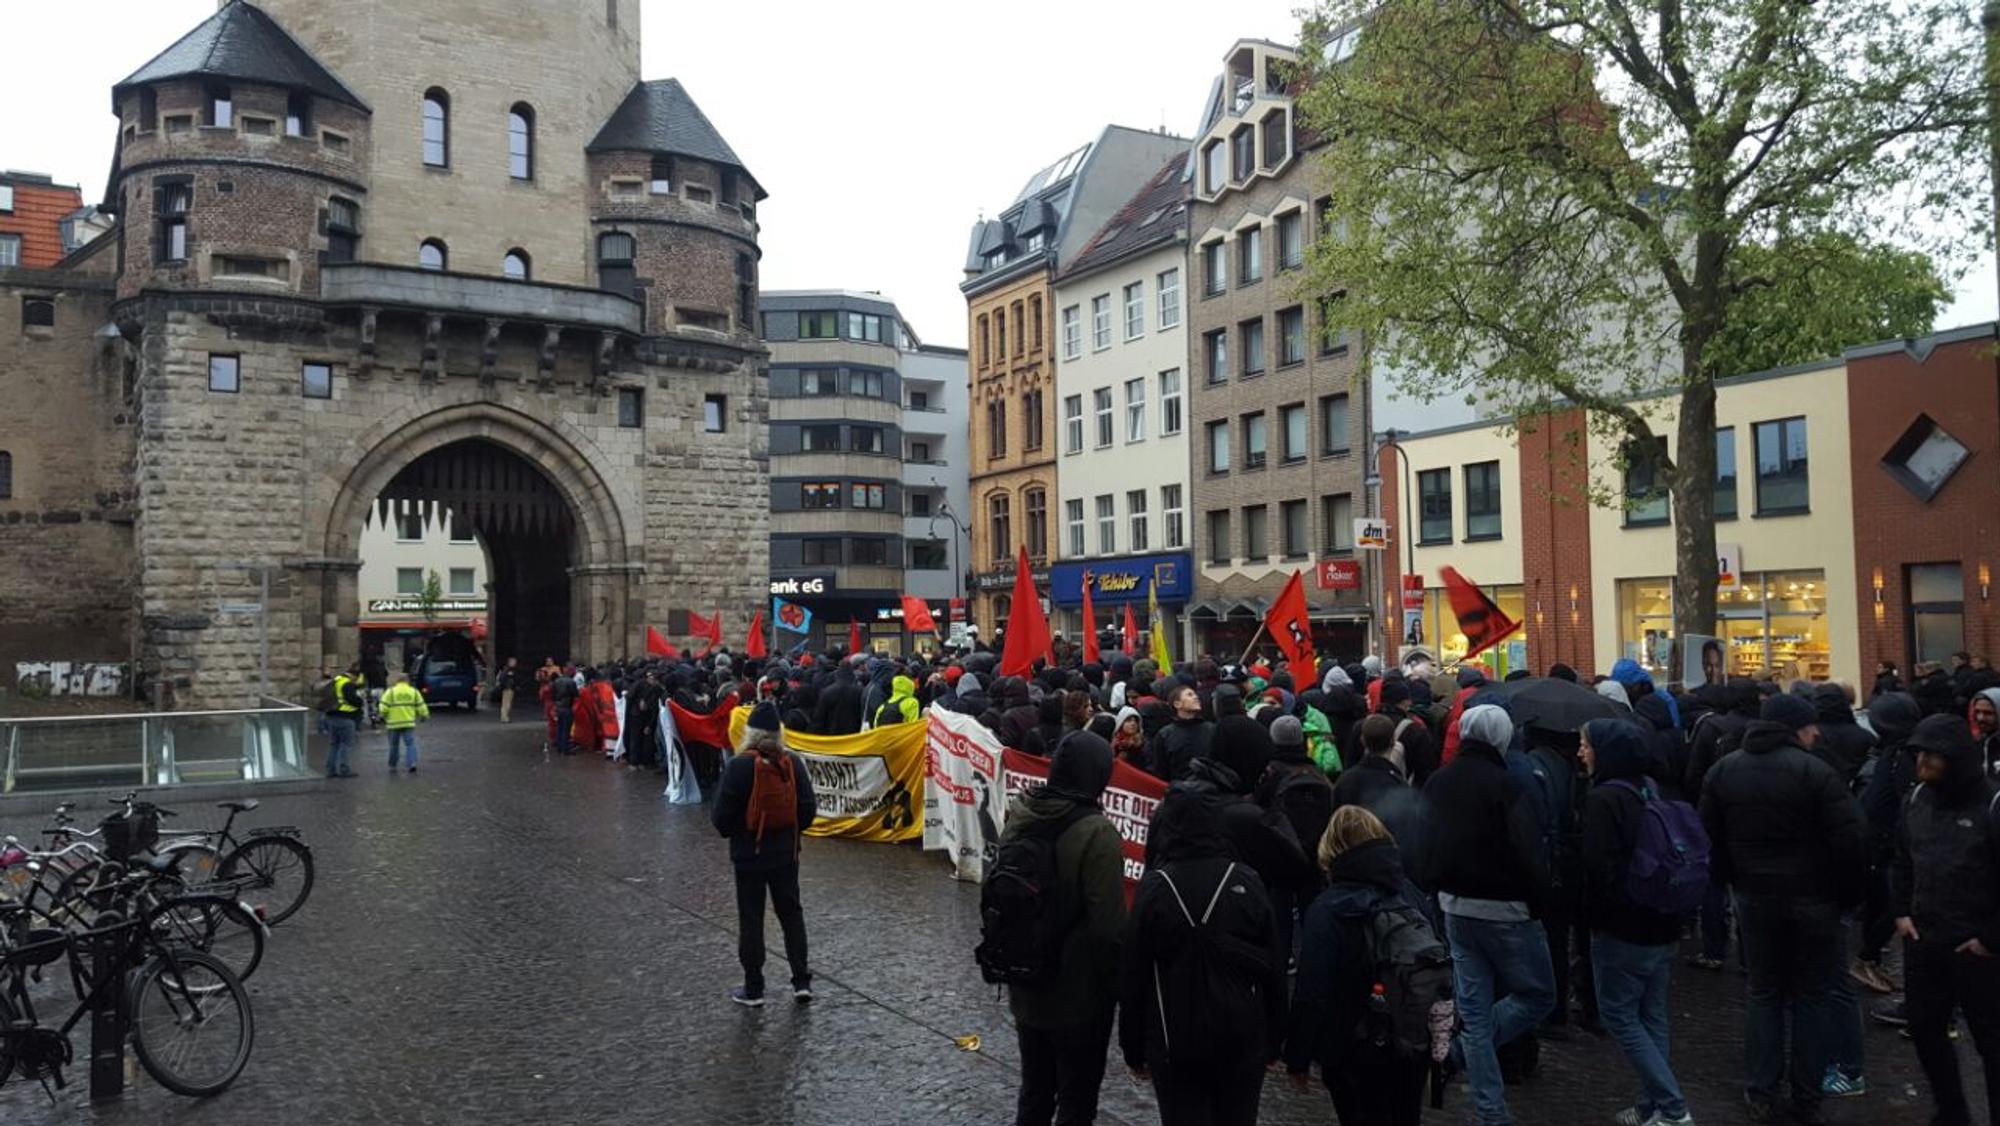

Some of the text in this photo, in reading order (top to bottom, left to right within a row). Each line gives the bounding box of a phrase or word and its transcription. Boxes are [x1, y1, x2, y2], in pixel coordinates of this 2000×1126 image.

[1363, 522, 1382, 538] dm
[770, 578, 824, 594] ank eG
[1099, 573, 1139, 591] Tchibo
